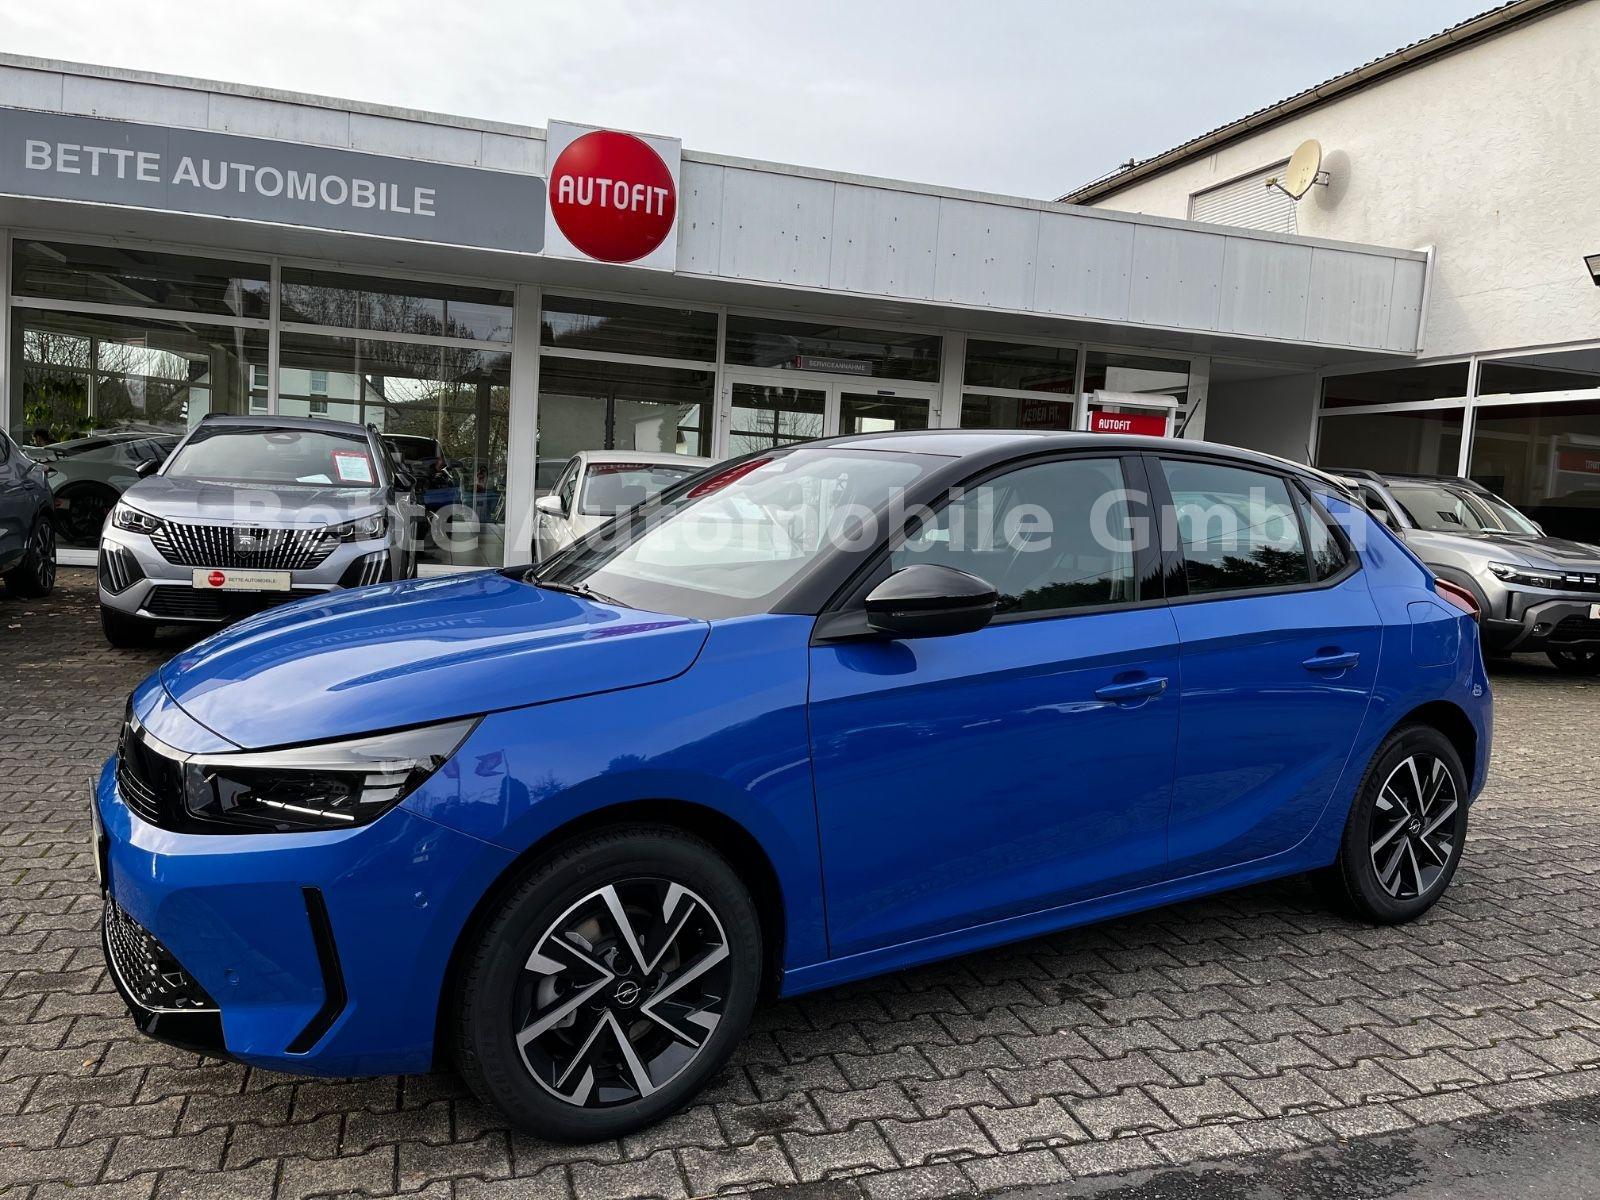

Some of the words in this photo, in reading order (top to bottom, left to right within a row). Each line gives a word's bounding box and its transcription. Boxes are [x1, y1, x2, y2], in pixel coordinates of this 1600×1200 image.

[25, 139, 161, 183] BETTE
[172, 155, 436, 217] AUTOMOBILE
[557, 174, 669, 217] AUTOFIT
[809, 360, 865, 371] SERVICEANNAHME
[1098, 418, 1132, 431] AUTOFIT
